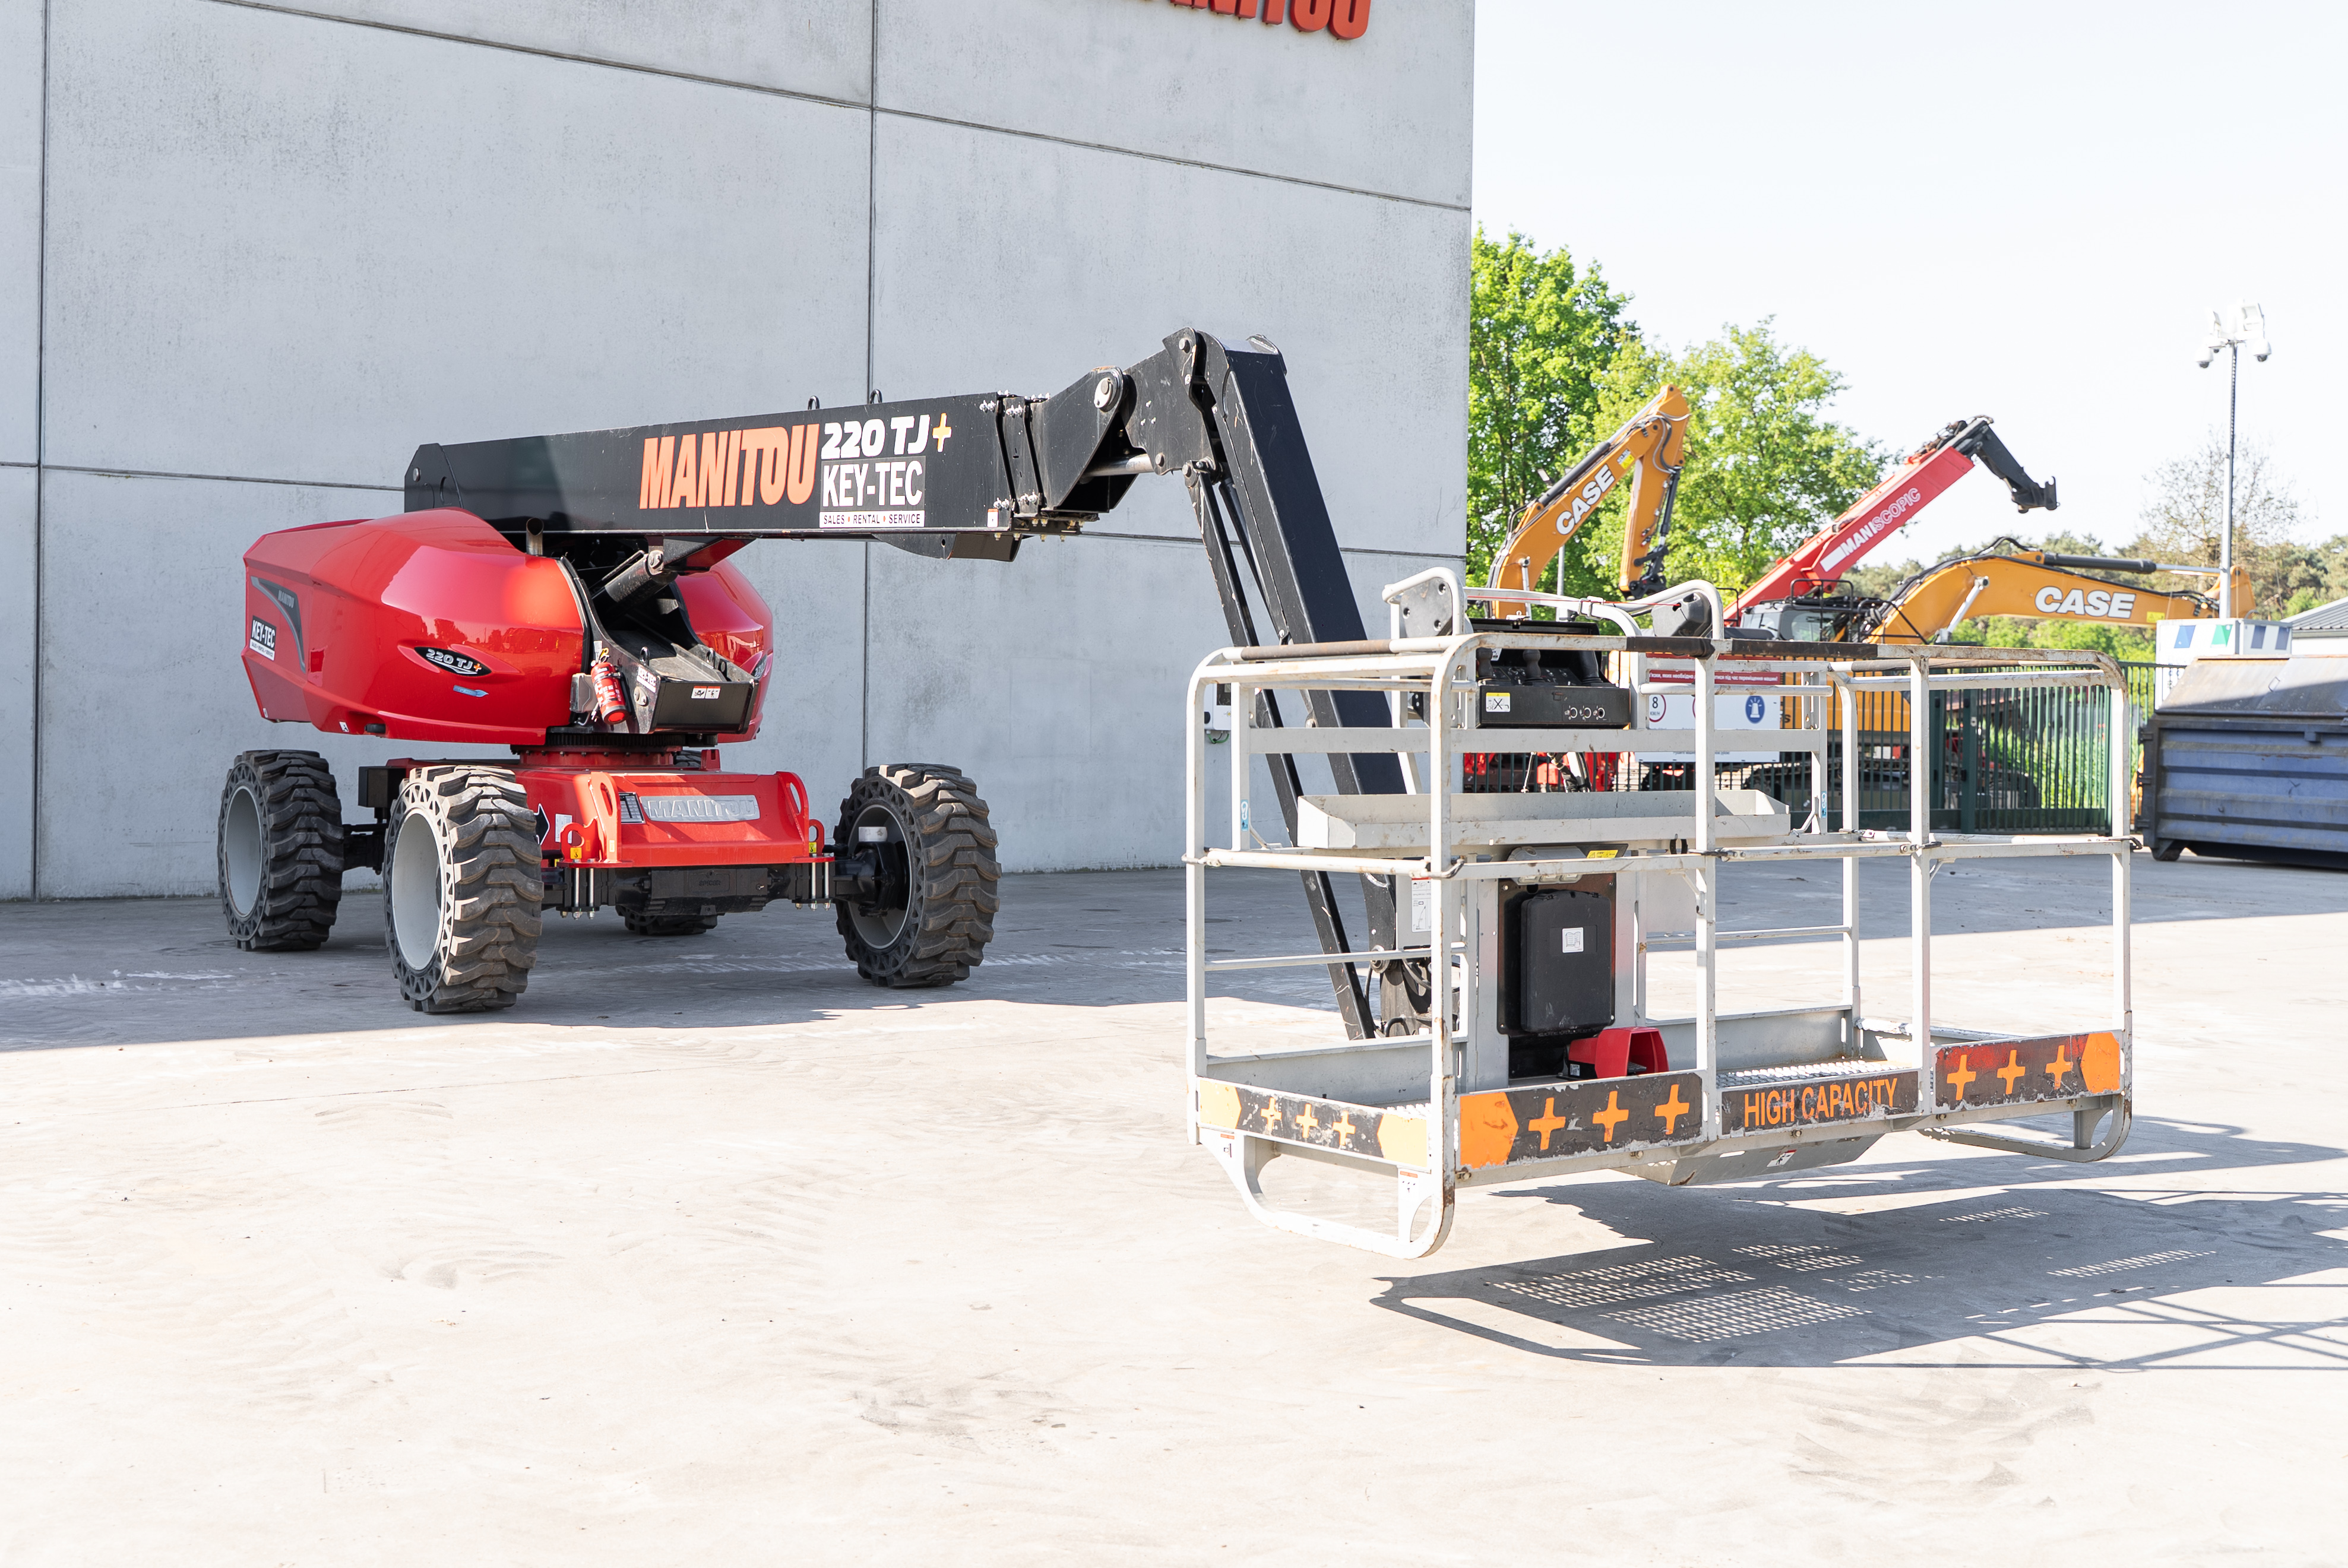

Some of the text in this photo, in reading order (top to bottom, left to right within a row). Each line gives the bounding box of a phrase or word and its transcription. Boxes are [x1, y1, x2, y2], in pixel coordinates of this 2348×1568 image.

[821, 419, 885, 459] 220
[640, 424, 819, 509] MANITOU
[822, 460, 923, 506] KEY-TEC
[1556, 464, 1615, 535] CASE
[824, 514, 920, 524] SALES RENTAL SERVICE
[1840, 487, 1921, 556] MANISCOPIC
[2034, 586, 2137, 619] CASE
[252, 620, 276, 648] KEY-TEC
[426, 648, 454, 664] 220
[1652, 696, 1659, 708] 8
[647, 799, 757, 818] MANITOU
[1745, 1078, 1898, 1127] HIGH CAPACITY
